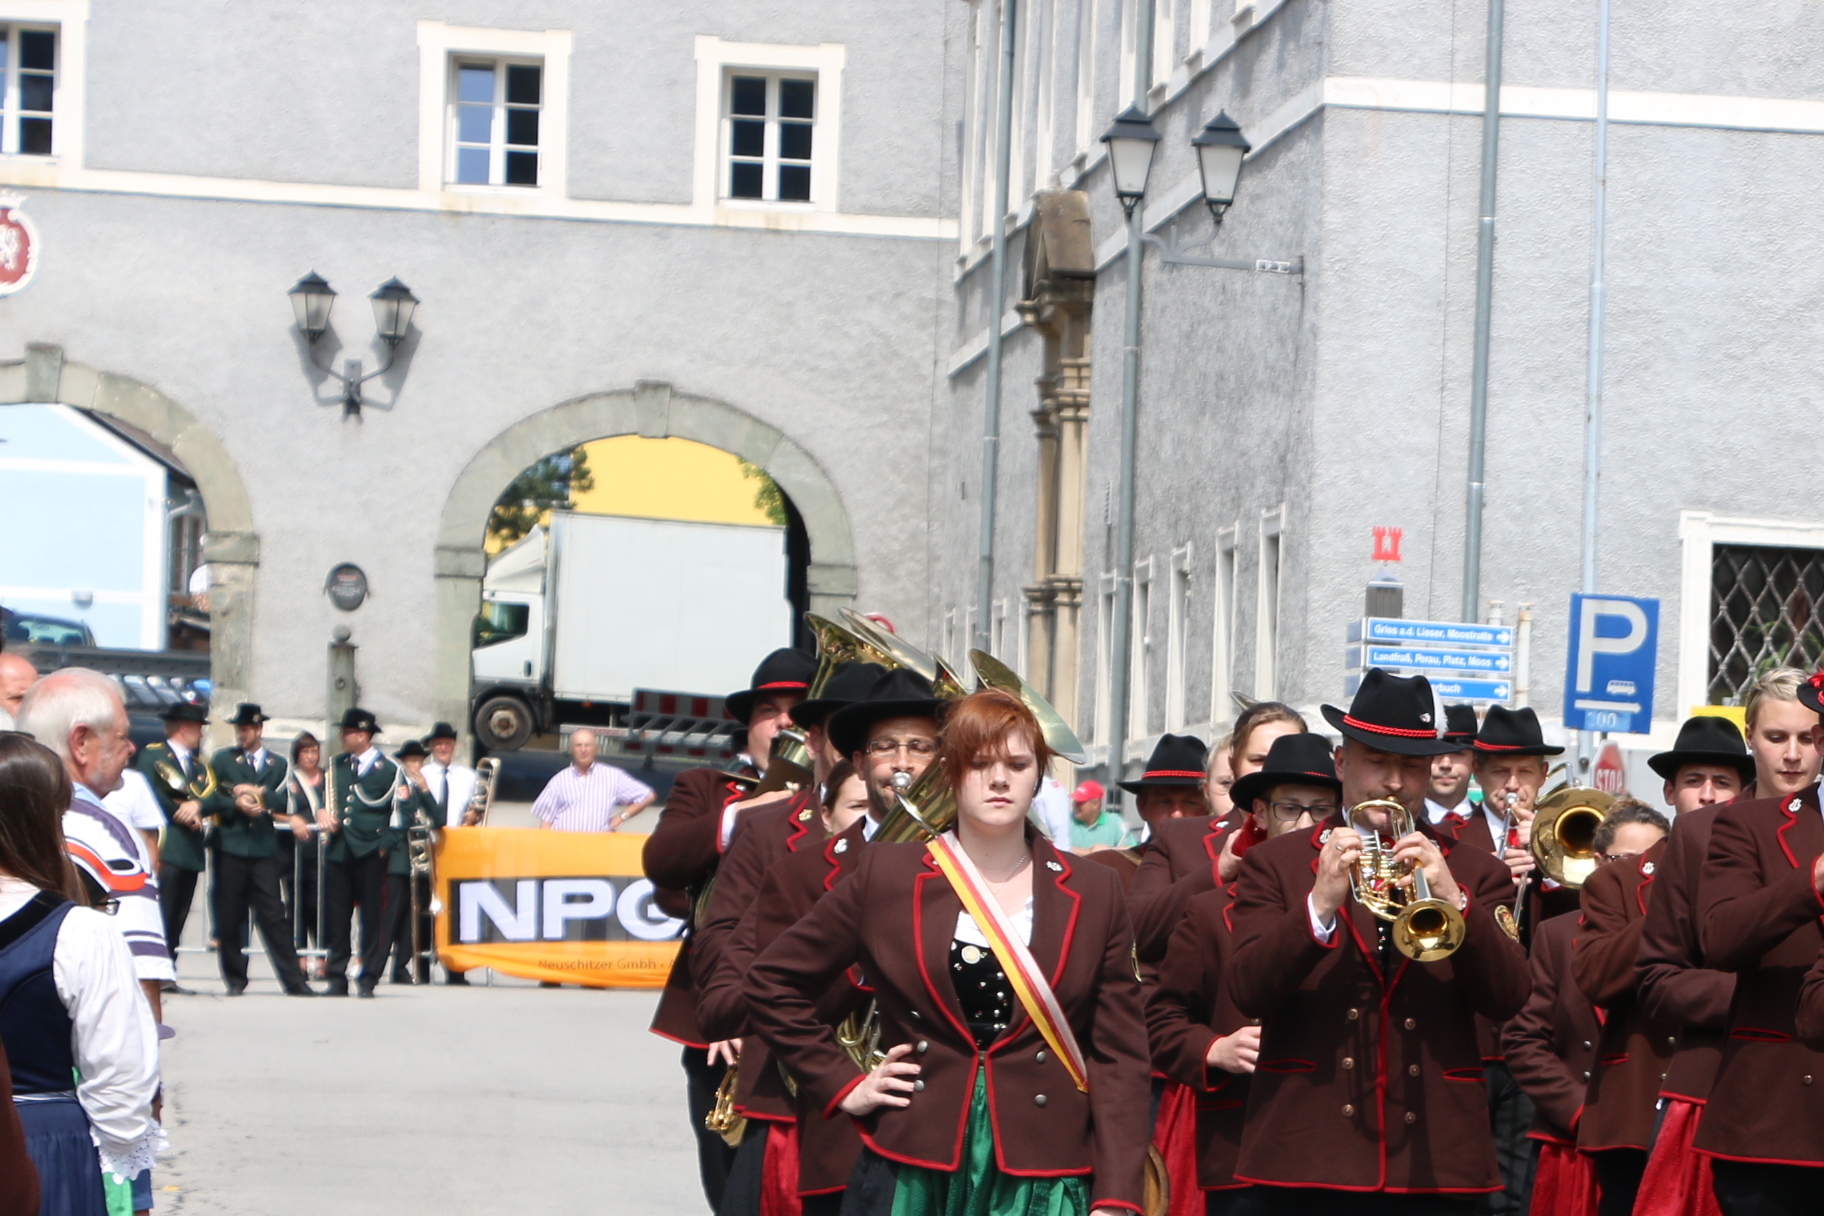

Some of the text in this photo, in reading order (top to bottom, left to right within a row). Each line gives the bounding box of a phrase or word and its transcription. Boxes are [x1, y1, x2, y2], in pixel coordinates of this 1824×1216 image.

[1576, 598, 1648, 693] P
[1468, 657, 1492, 667] Moos
[1596, 769, 1623, 793] STOP
[538, 958, 613, 970] Neuschitzer
[616, 958, 656, 970] Gmbh
